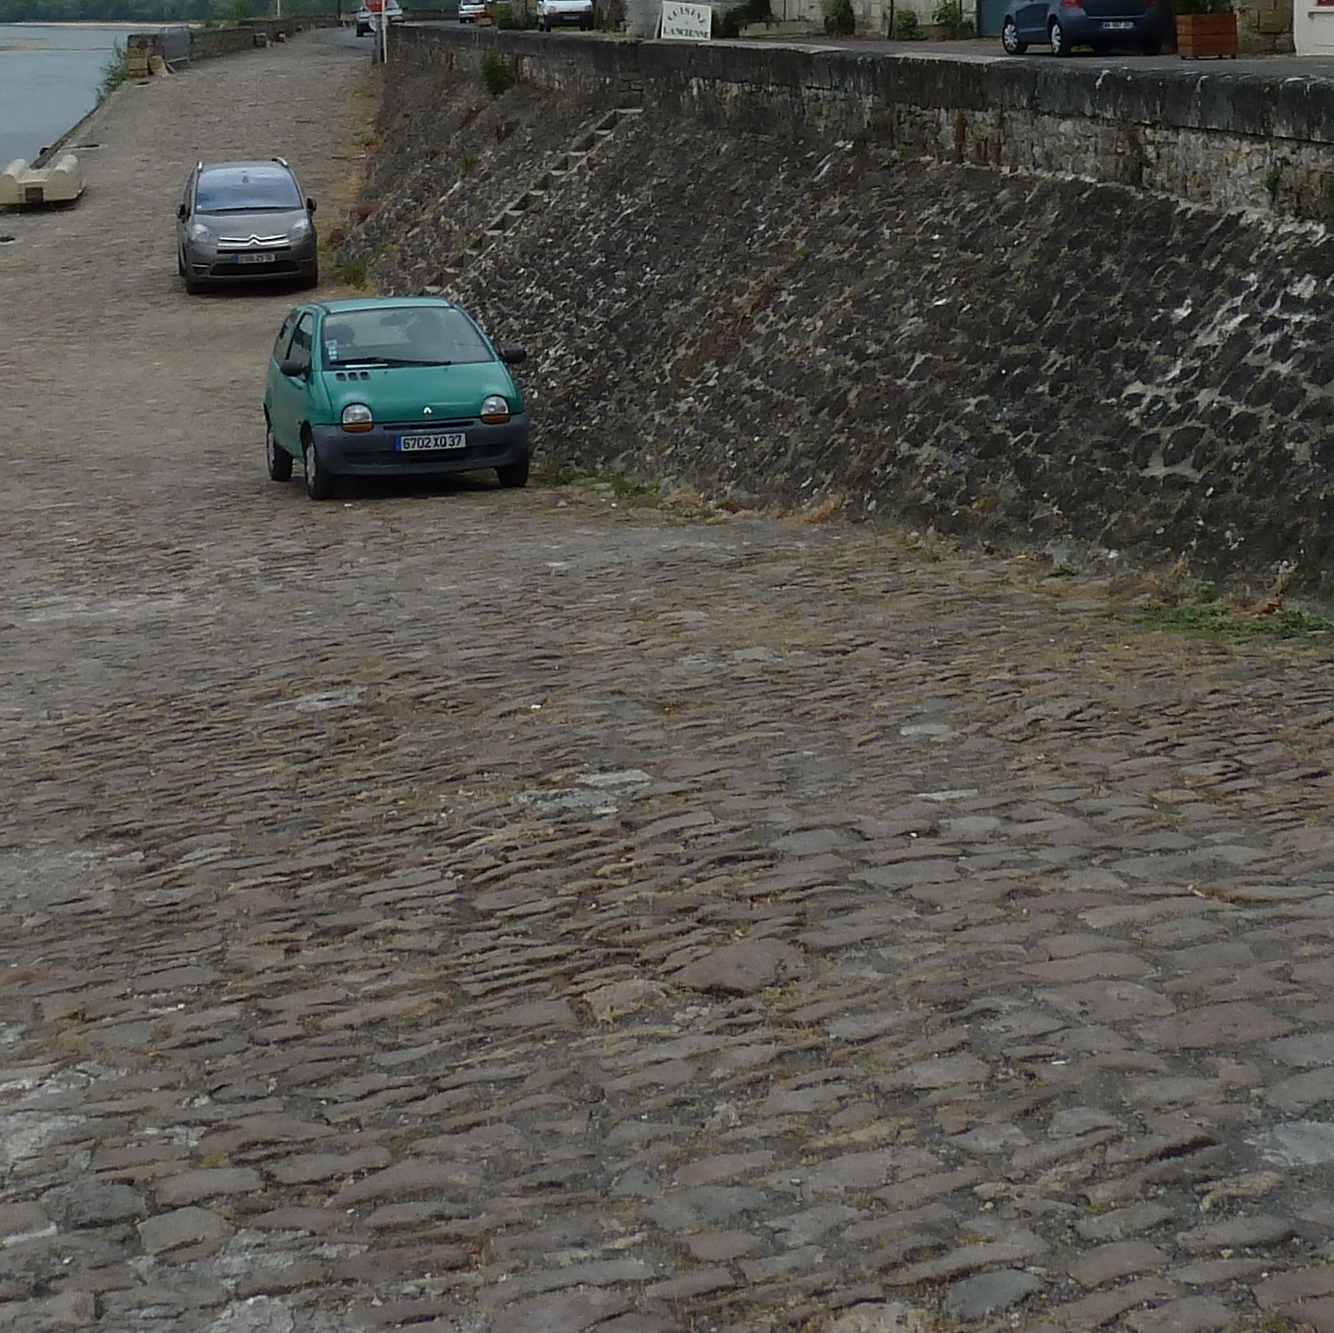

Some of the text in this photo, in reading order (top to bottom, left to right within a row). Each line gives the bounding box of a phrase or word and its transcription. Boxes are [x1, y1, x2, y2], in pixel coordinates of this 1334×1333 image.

[667, 6, 706, 25] CUISINE
[403, 437, 431, 450] 6702
[448, 435, 462, 447] 37
